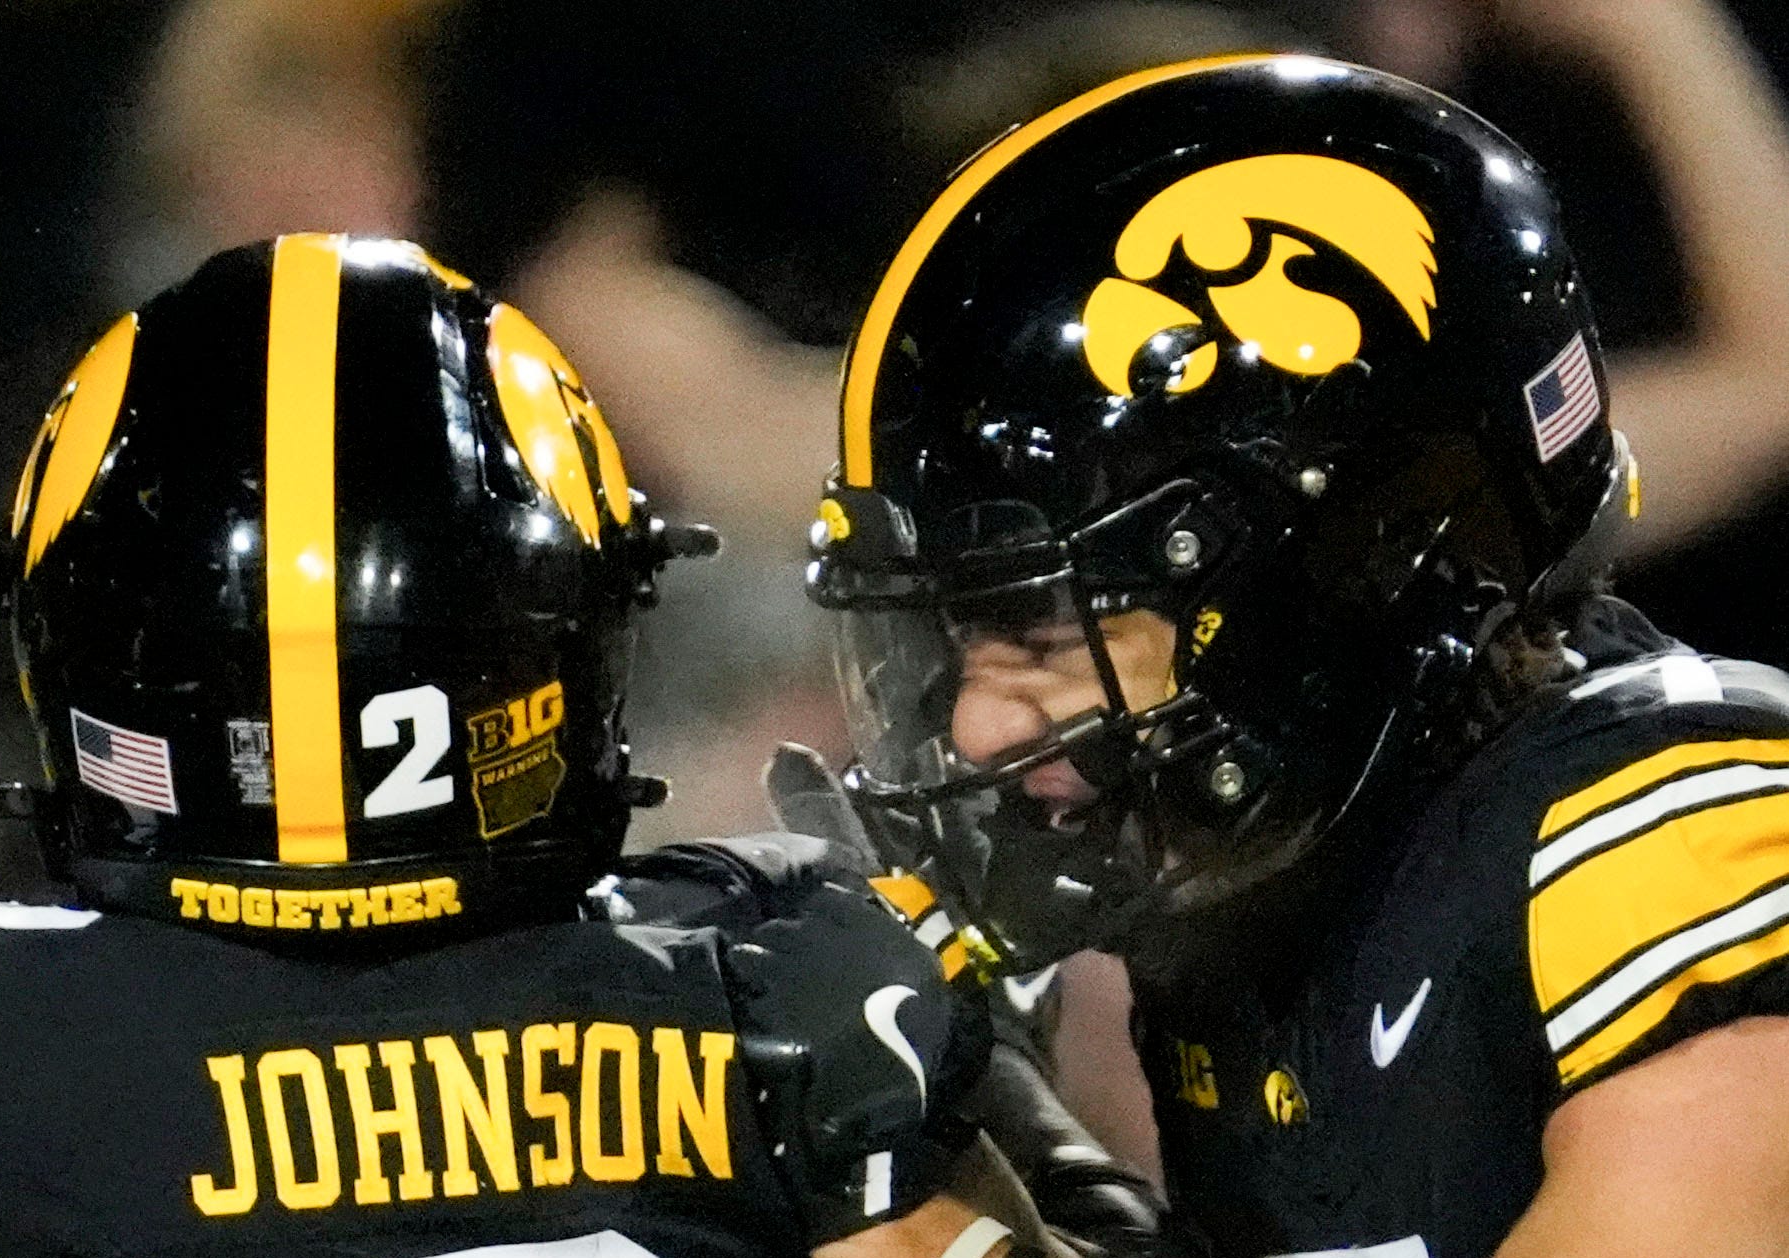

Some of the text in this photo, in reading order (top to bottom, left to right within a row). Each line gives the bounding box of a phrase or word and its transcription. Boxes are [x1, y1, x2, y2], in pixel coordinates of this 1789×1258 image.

[360, 684, 453, 818] 2
[171, 877, 462, 929] TOGETHER
[192, 1022, 735, 1216] JOHNSON
